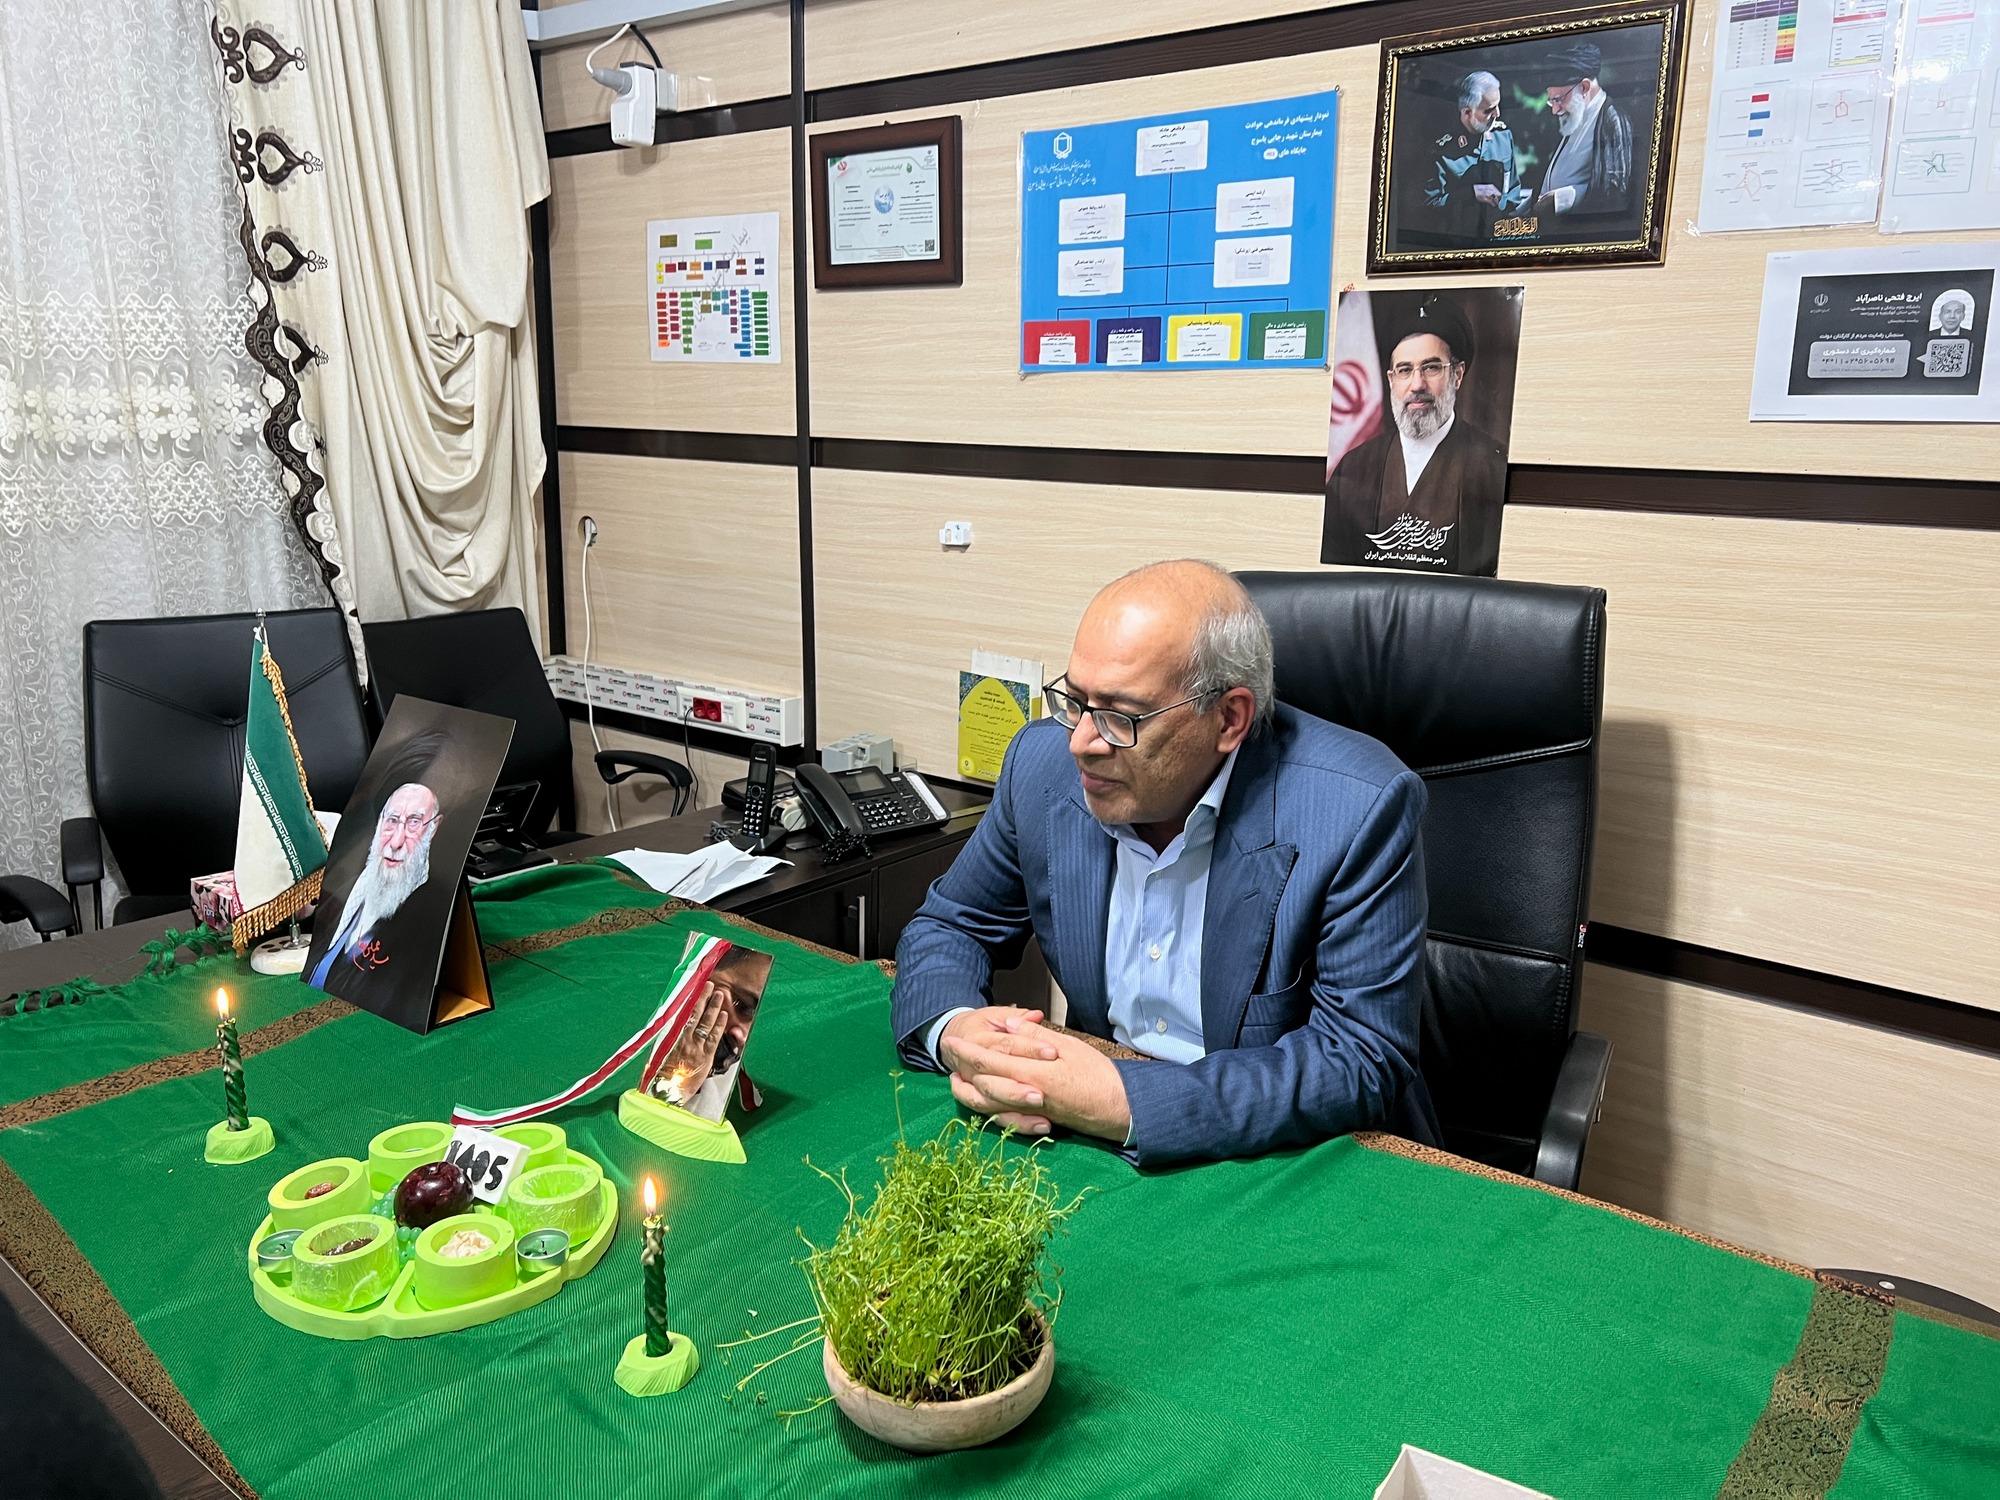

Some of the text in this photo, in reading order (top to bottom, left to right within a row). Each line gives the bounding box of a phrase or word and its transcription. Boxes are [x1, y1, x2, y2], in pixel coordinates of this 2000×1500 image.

[1884, 292, 1905, 303] فتحی
[1906, 292, 1922, 302] ایرج
[1364, 550, 1447, 566] رهبر معظم انقلاب اسلامی ایران
